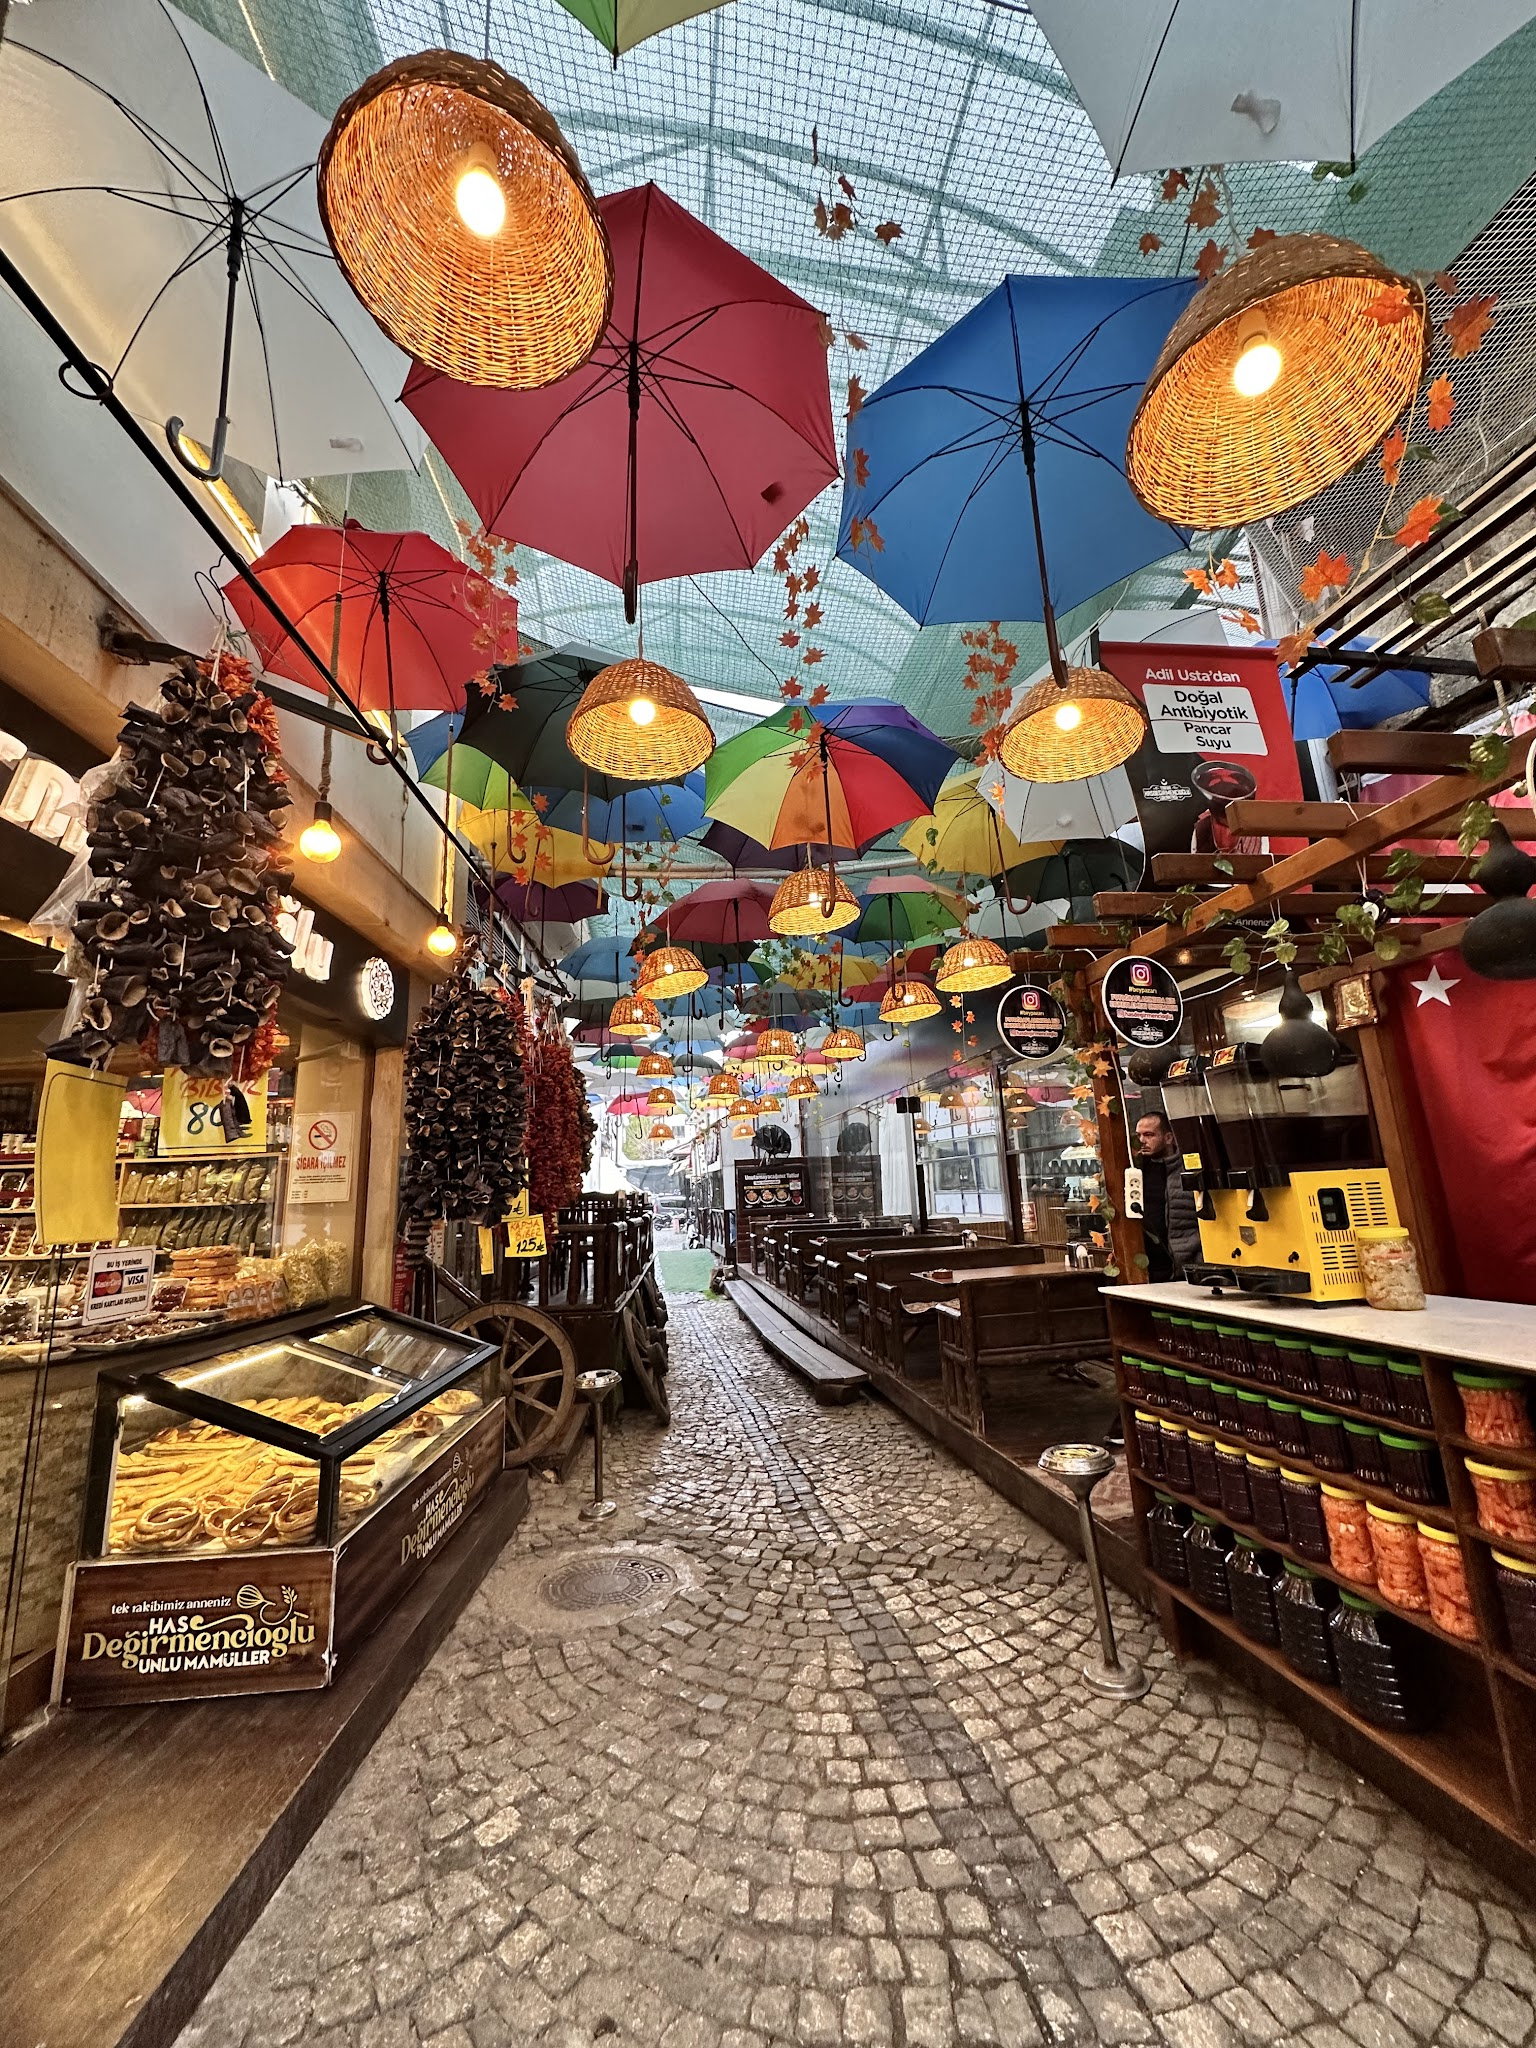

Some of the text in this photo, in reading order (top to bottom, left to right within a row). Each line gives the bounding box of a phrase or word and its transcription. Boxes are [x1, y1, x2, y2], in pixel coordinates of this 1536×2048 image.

[1146, 668, 1241, 683] Adil Usta'dan
[1174, 690, 1223, 705] Doğal
[1161, 705, 1248, 721] Antibiyotik
[1184, 722, 1232, 735] Pancar
[1196, 736, 1231, 750] Suyu
[128, 1275, 144, 1285] VISA
[112, 1596, 231, 1614] tek rakibimiz anneniz
[149, 1616, 188, 1635] HAS
[138, 1650, 270, 1674] UNLU MAMÜLLER
